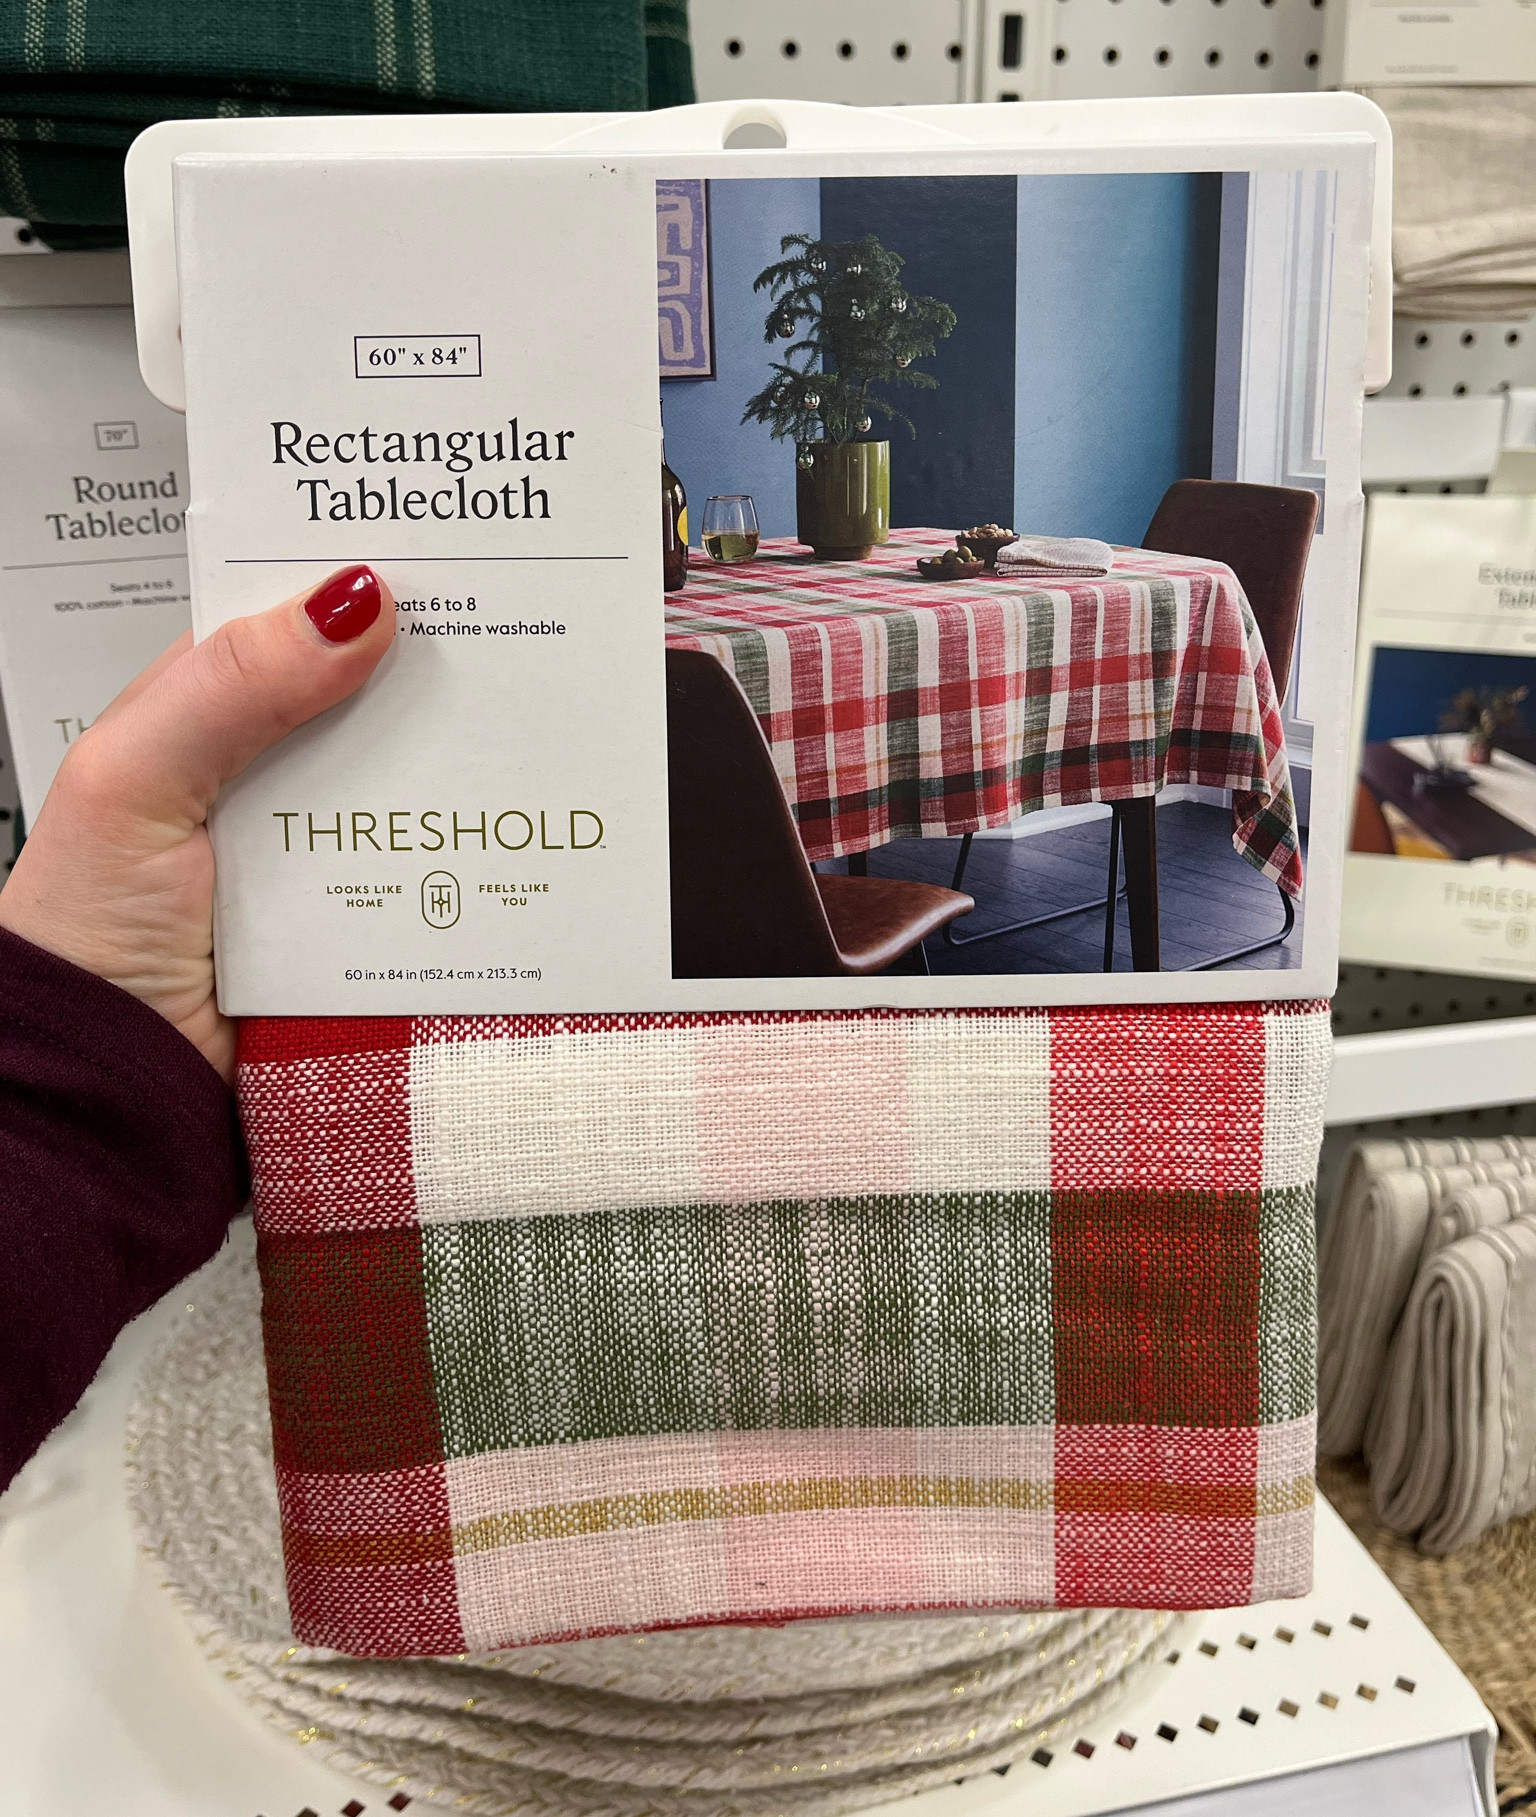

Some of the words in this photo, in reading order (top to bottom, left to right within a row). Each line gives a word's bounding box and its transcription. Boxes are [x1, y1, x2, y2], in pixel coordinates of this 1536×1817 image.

[368, 347, 406, 366] 60"
[413, 352, 425, 366] x
[431, 346, 467, 366] 84"
[270, 416, 575, 473] Rectangular
[72, 471, 179, 505] Round
[296, 474, 552, 521] Tablecloth
[45, 508, 186, 541] Tableclo
[394, 598, 427, 612] eats
[430, 597, 441, 612] 6
[444, 598, 463, 612] to
[466, 597, 477, 612] 8
[409, 621, 482, 636] Machine
[485, 620, 566, 636] washable
[272, 810, 604, 852] THRESHOLD
[326, 885, 370, 895] LOOKS
[374, 885, 402, 894] LIKE
[478, 883, 517, 894] FEELS
[521, 883, 549, 893] LIKE
[346, 898, 384, 908] HOME
[501, 897, 527, 906] YOU
[345, 969, 363, 981] 60
[365, 969, 376, 980] in
[378, 972, 386, 981] x
[387, 969, 404, 981] 84
[406, 969, 417, 980] in
[419, 968, 454, 983] (152.4
[456, 971, 475, 980] cm
[477, 971, 484, 980] x
[486, 967, 518, 980] 213.3
[520, 967, 542, 982] cm)
